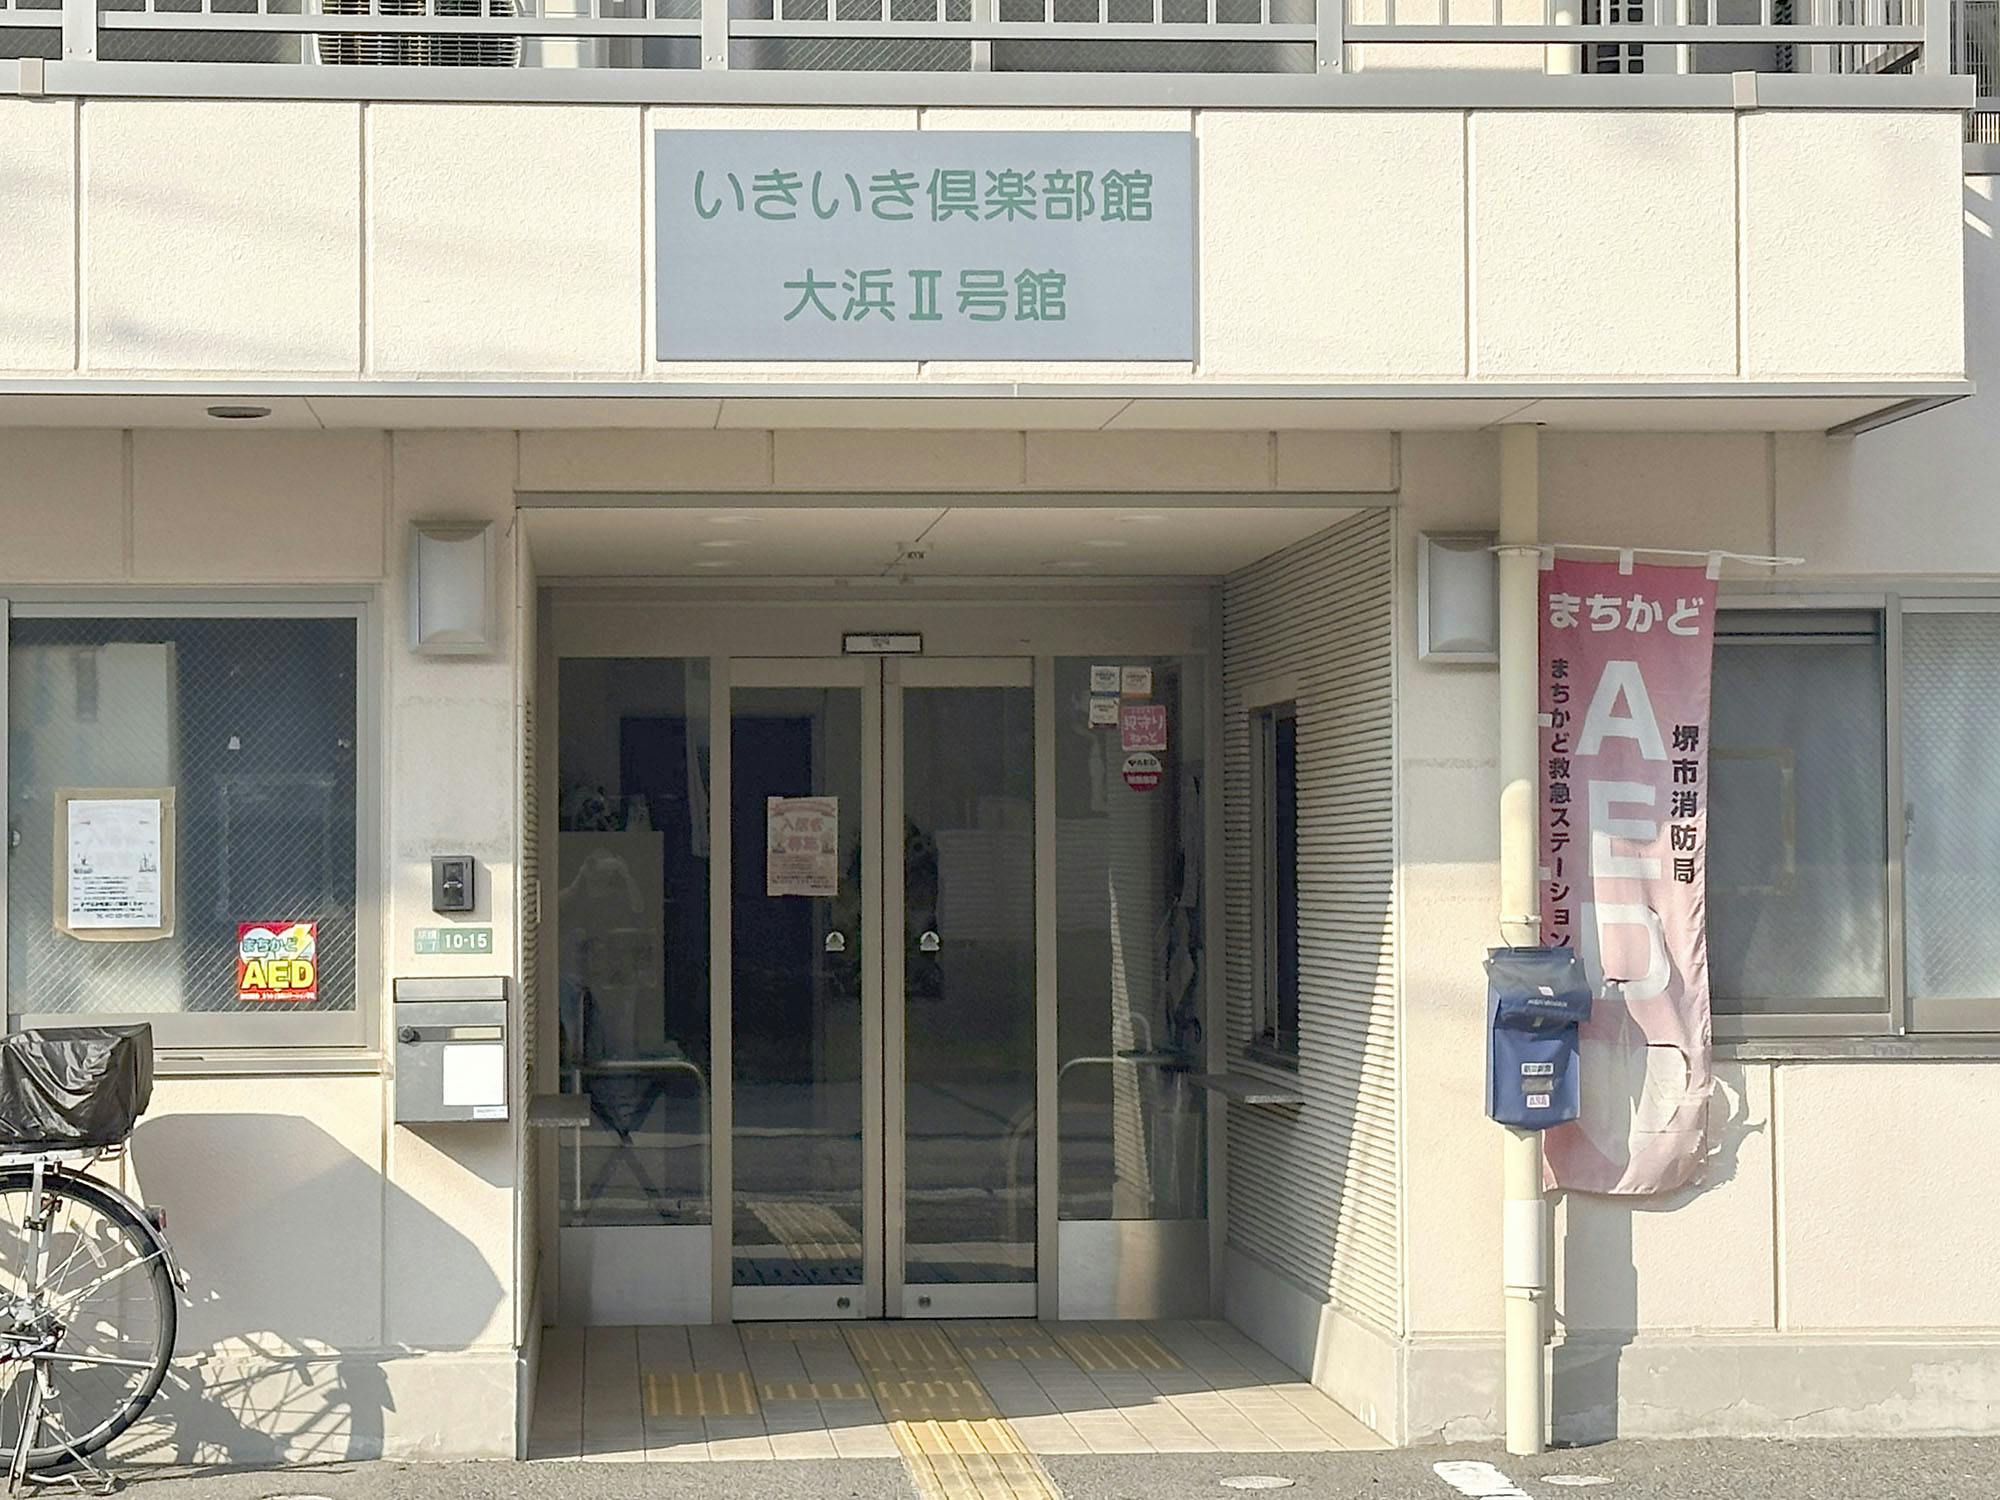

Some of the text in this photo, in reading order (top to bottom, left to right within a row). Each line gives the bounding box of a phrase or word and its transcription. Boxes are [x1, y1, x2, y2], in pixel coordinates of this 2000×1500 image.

[693, 168, 1153, 222] いきいき倶楽部館
[1548, 593, 1703, 636] まちかど
[1669, 724, 1700, 885] 堺市消防局
[242, 937, 298, 952] まちかど
[240, 960, 315, 990] AED
